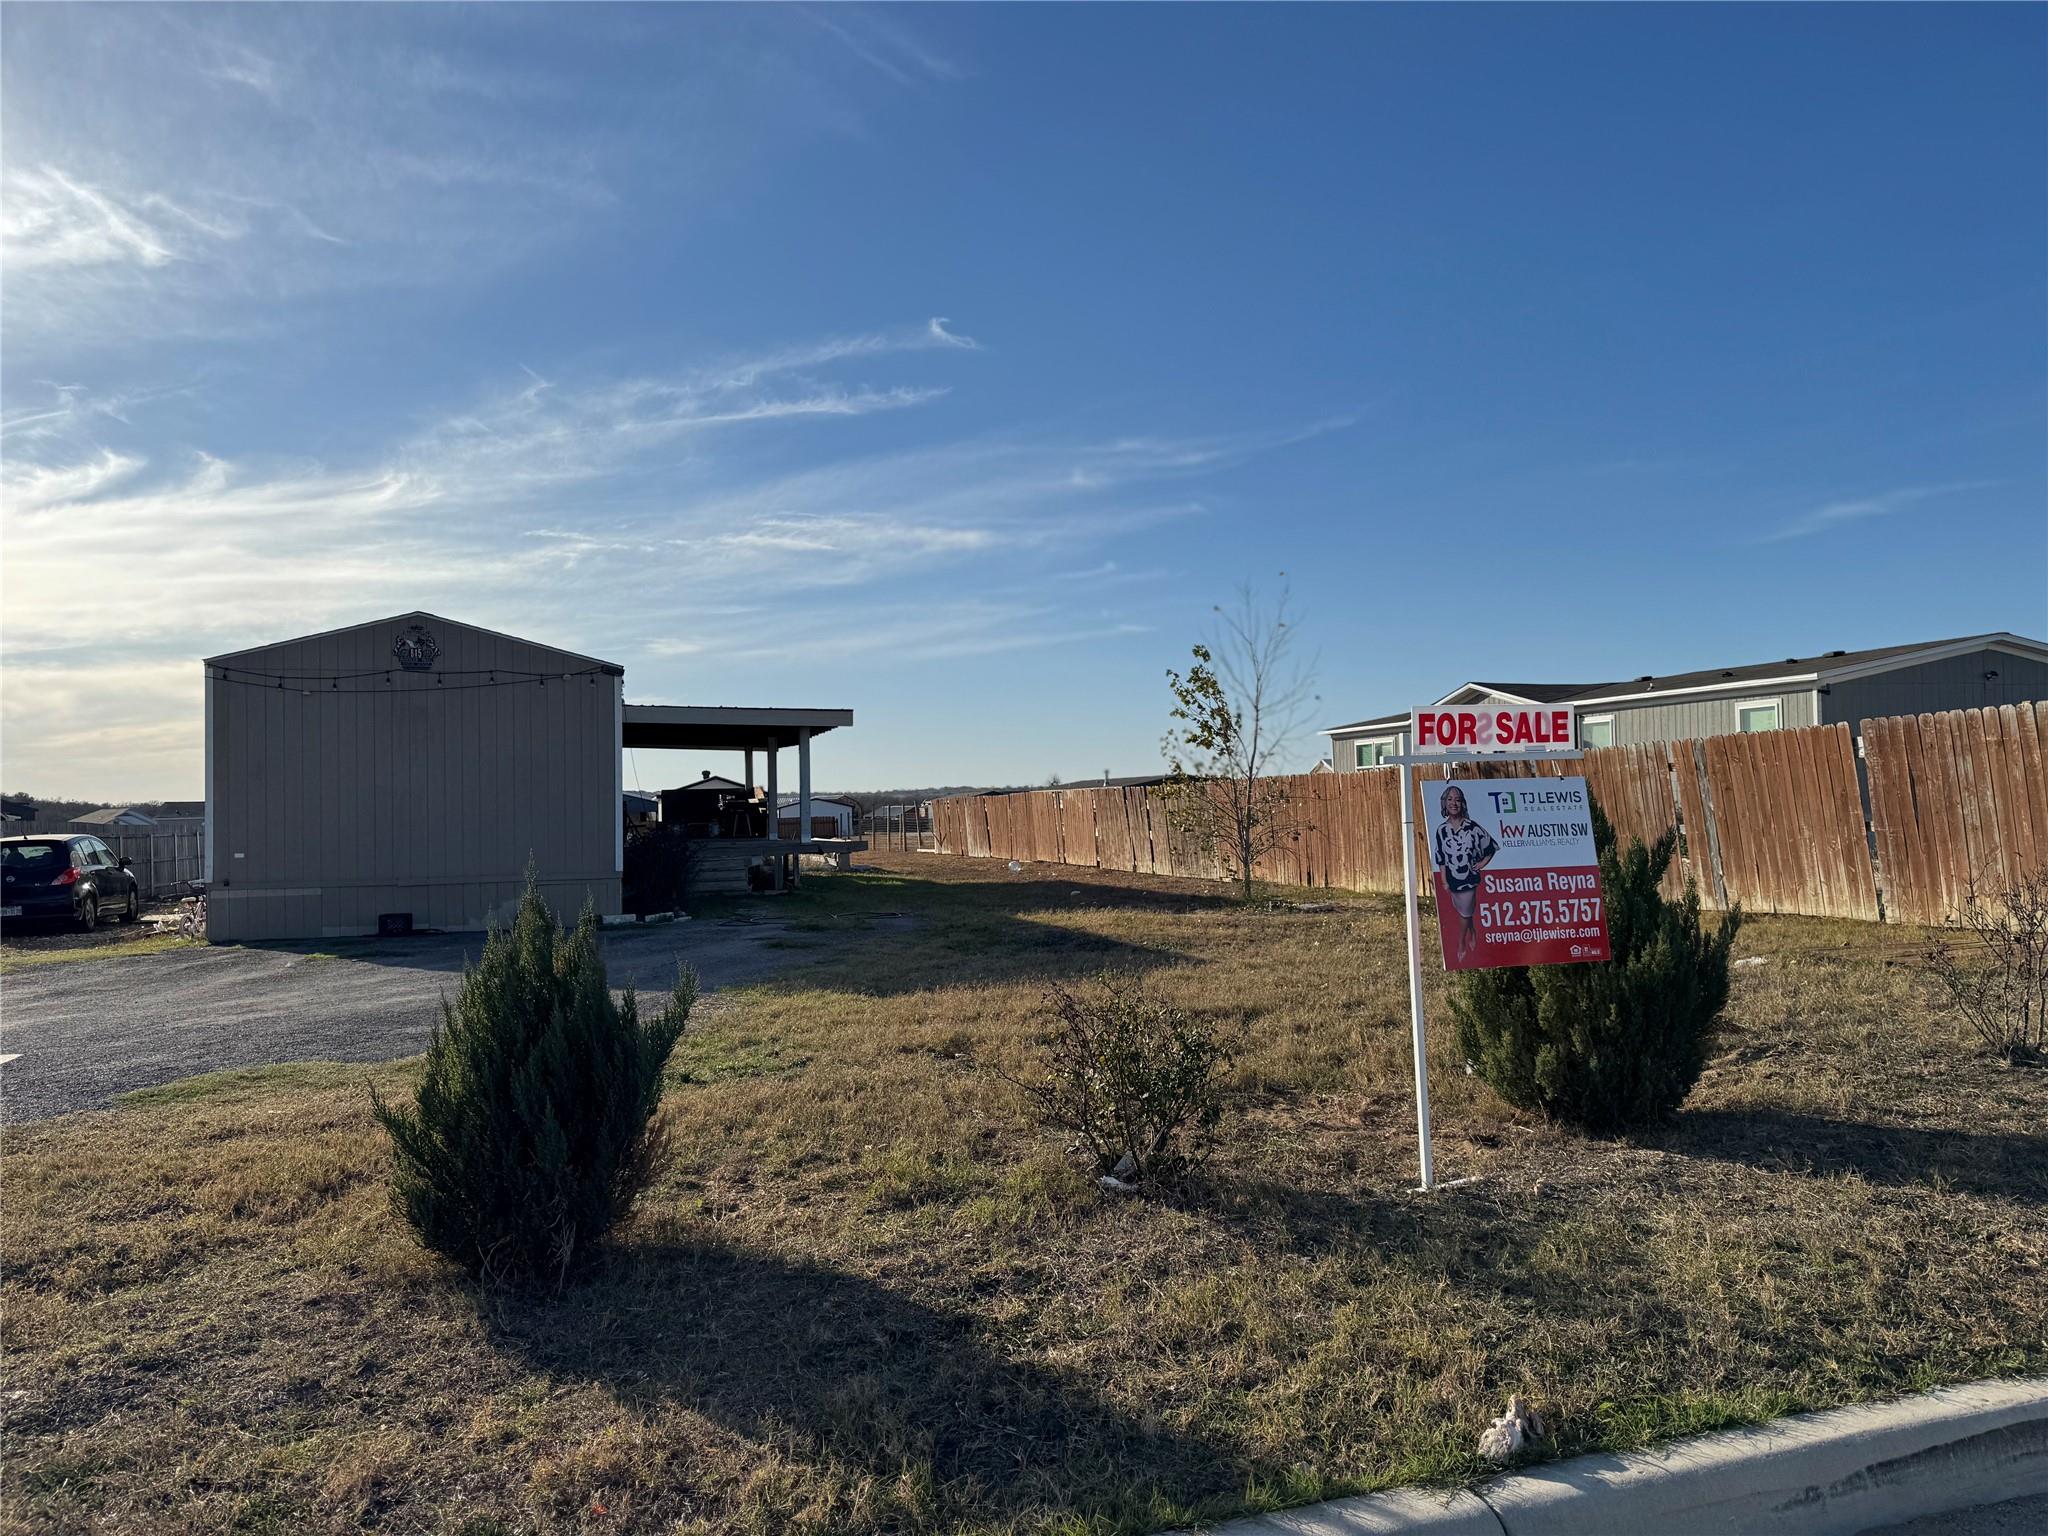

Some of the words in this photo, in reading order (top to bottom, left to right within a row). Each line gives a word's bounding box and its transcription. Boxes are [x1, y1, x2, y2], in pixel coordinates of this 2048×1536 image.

[1418, 712, 1477, 746] FOR
[1496, 711, 1569, 744] SALE
[1520, 792, 1535, 804] TJ
[1538, 791, 1582, 803] LEWIS
[1500, 820, 1525, 839] kw
[1527, 823, 1569, 838] AUSTIN
[1571, 823, 1588, 836] SW
[1484, 874, 1543, 893] Susana
[1546, 872, 1596, 893] Reyna
[1480, 898, 1600, 927] 512.375.5757
[1485, 927, 1600, 944] sreyna@tjlewisre.com
